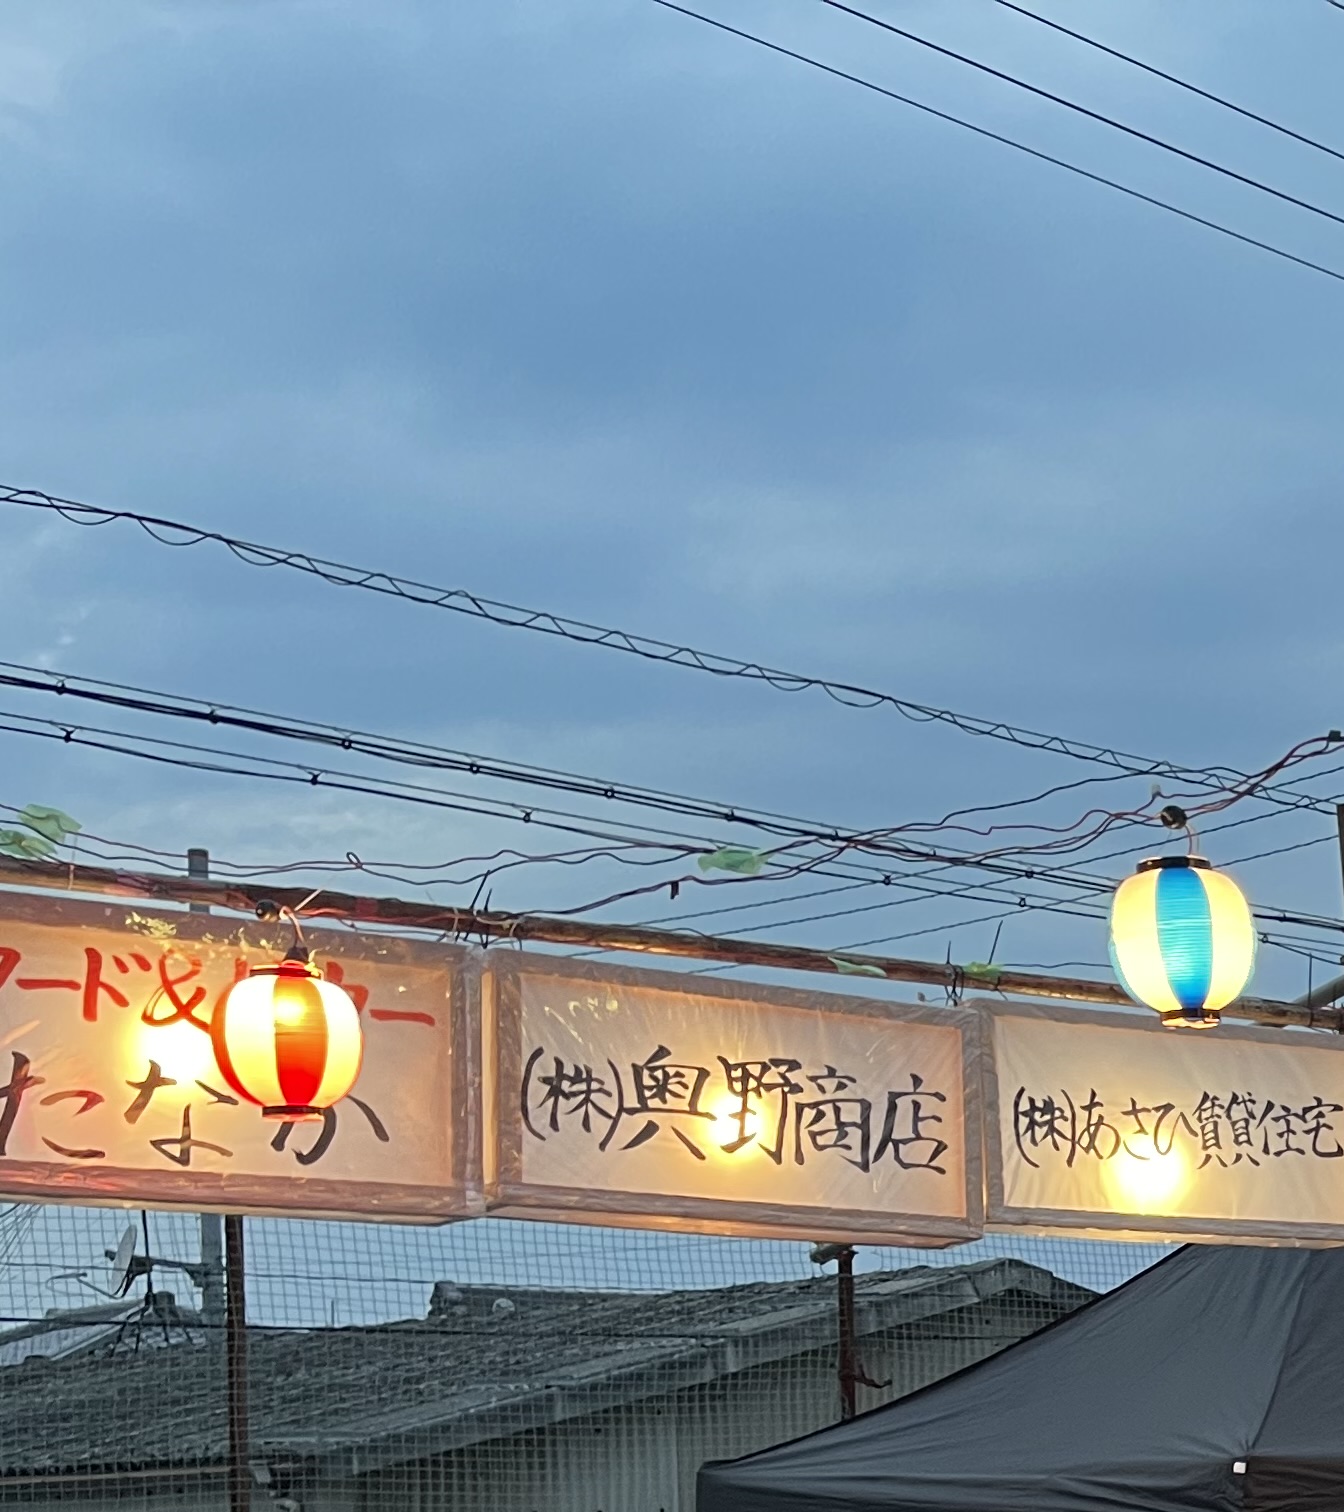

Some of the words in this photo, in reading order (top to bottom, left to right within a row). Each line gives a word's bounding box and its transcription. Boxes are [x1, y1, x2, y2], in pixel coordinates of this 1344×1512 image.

[1012, 1084, 1344, 1170] (株)あさひ賃貸住宅
